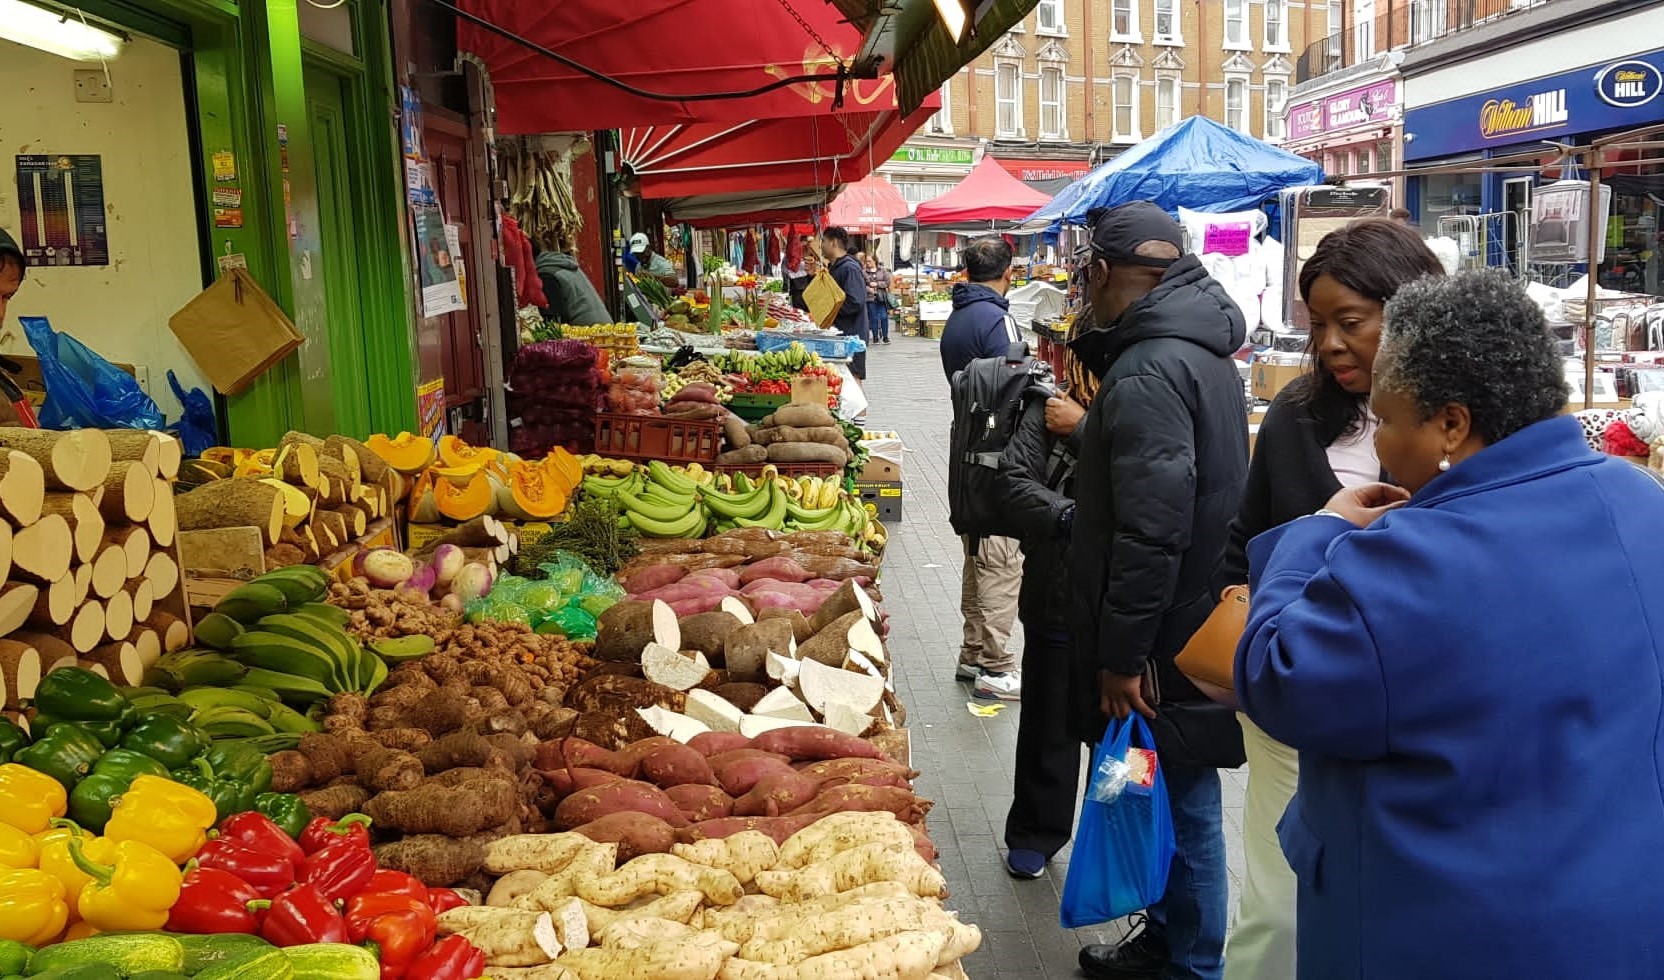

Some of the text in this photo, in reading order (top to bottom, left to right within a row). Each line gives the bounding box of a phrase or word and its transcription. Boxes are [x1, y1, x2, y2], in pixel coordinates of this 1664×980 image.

[1614, 71, 1647, 82] William
[1614, 82, 1646, 98] HILL
[1480, 89, 1568, 137] William HILL
